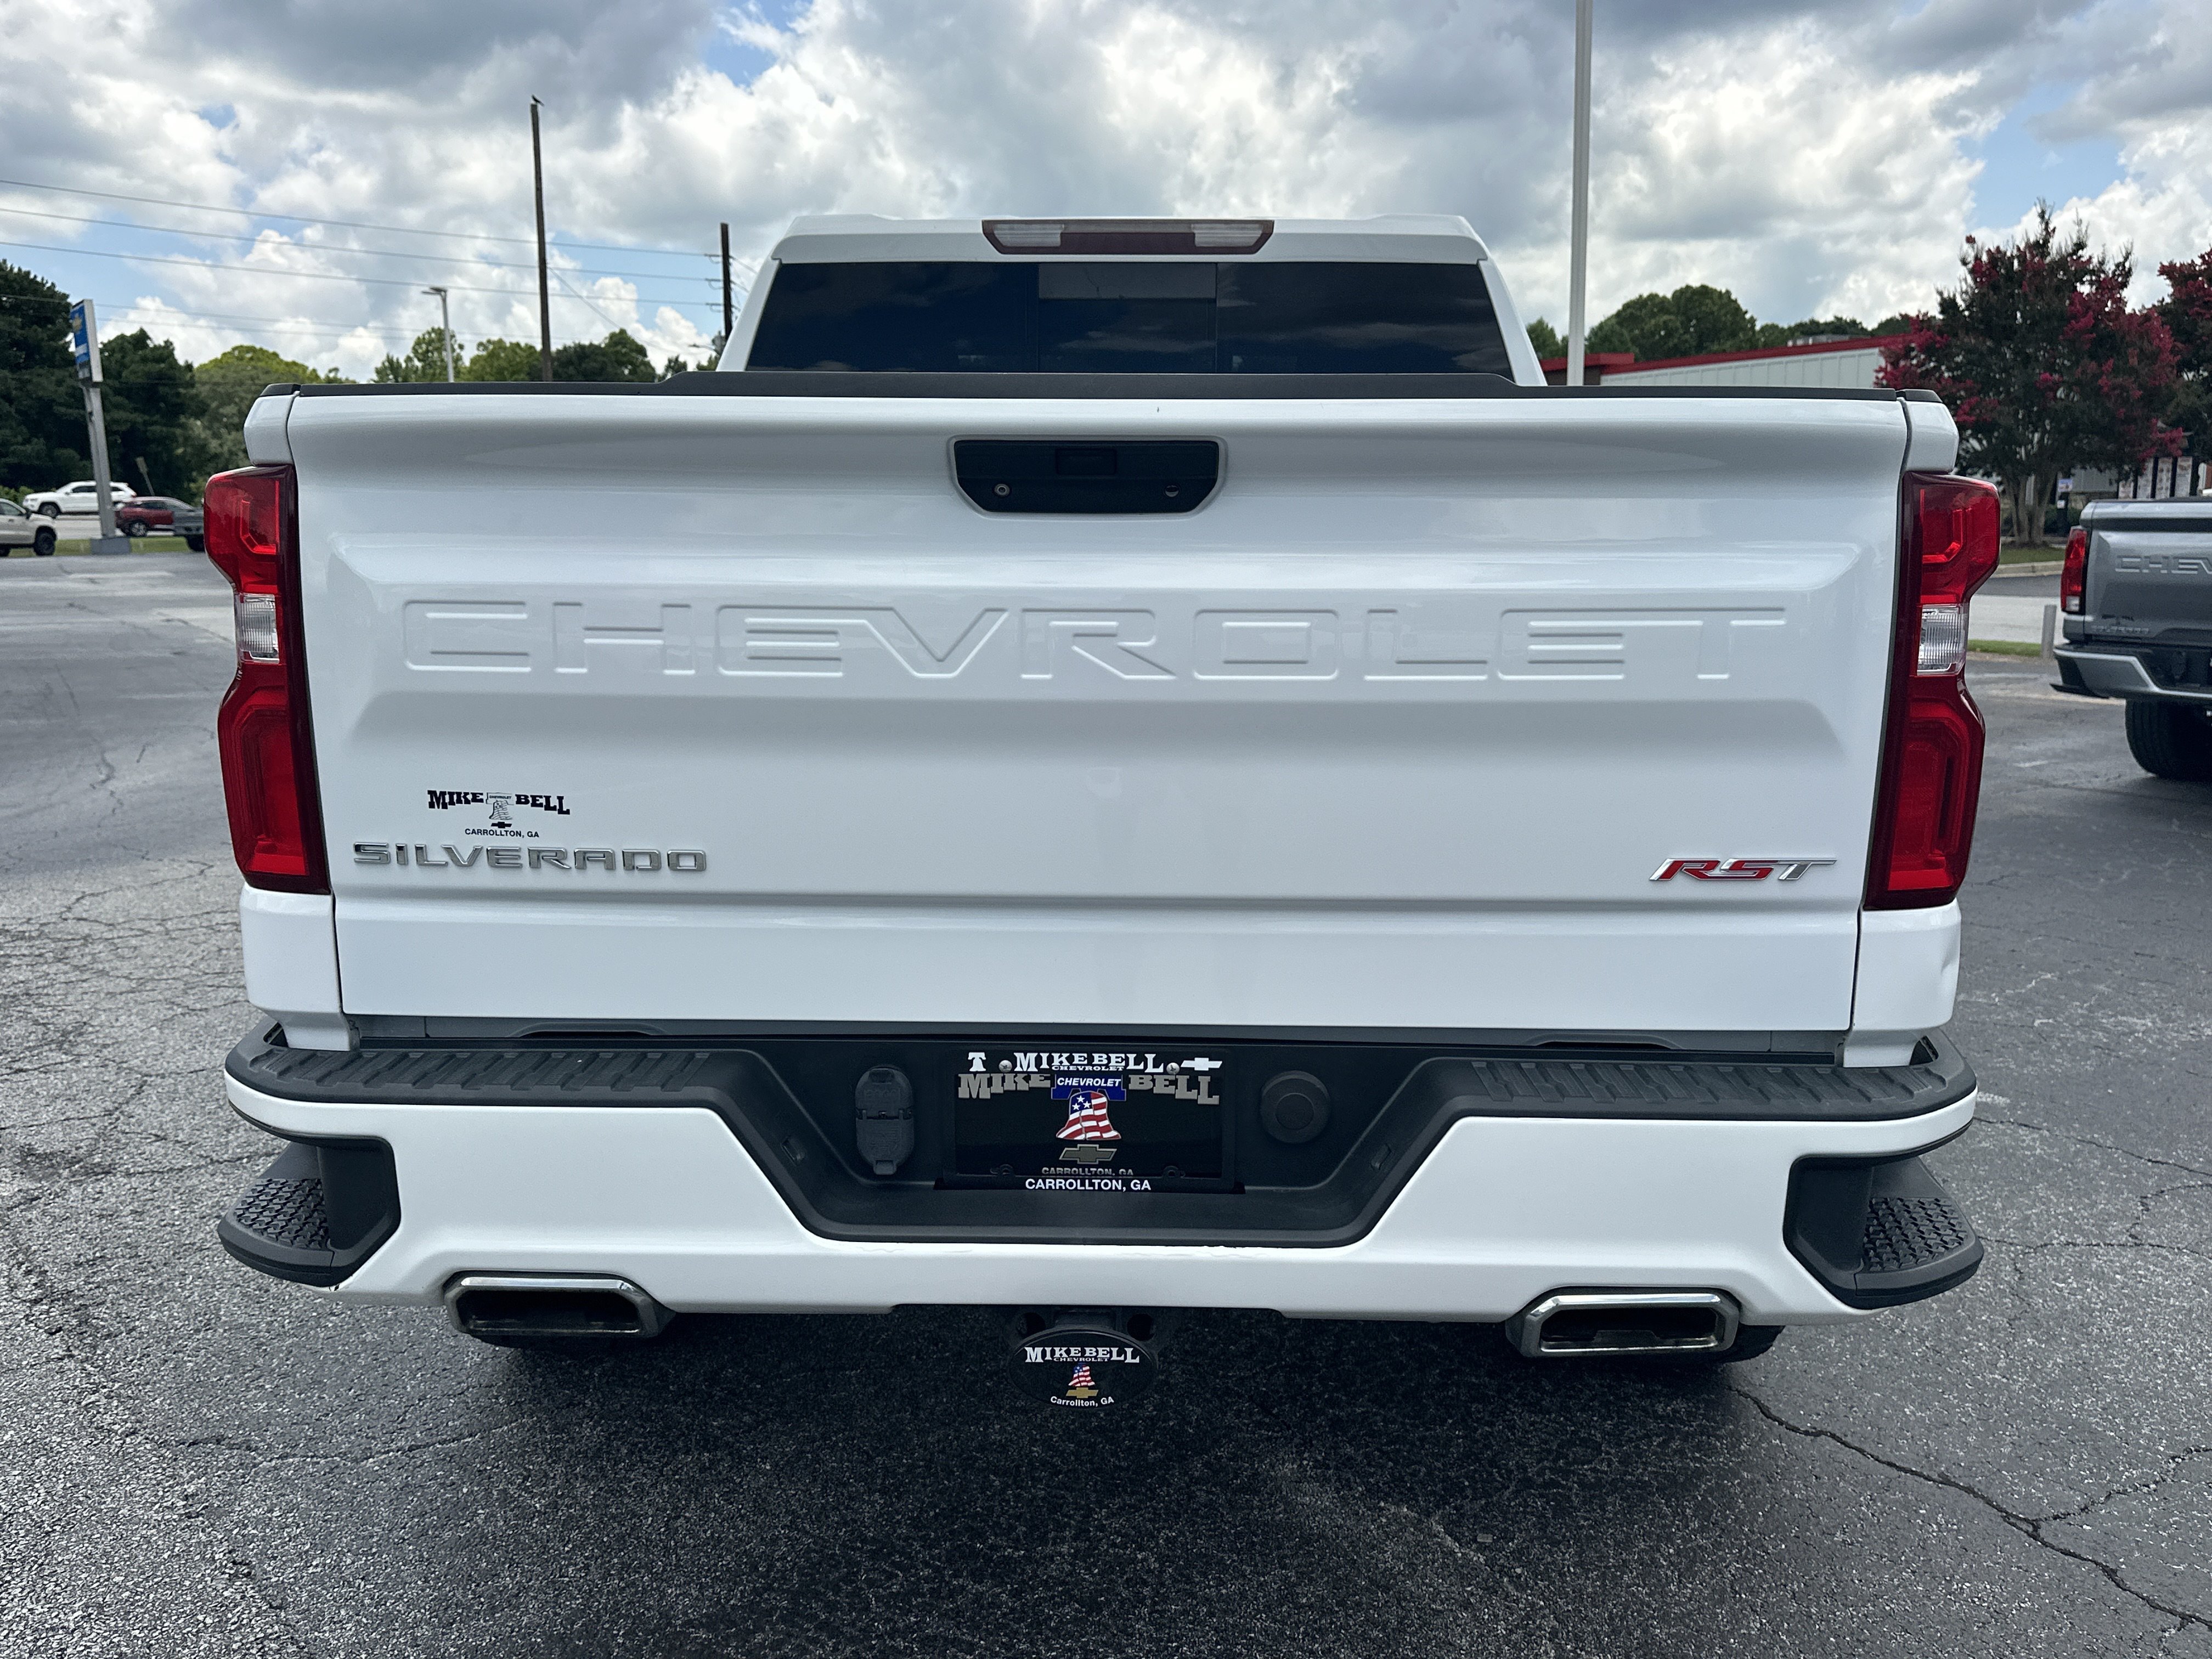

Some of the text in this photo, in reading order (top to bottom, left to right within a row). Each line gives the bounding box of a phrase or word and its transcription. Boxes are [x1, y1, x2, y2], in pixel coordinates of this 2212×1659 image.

[403, 600, 1786, 680] CHEVROLET
[427, 790, 571, 815] MIKE BELL
[465, 828, 524, 838] CARROLLTON,
[353, 842, 707, 871] SILVERADO
[1649, 858, 1837, 881] RST
[1014, 1052, 1164, 1073] MIKE BELL
[958, 1073, 1220, 1105] MIKE BELL
[1057, 1077, 1121, 1087] CHEVROLET
[1025, 1178, 1152, 1192] CARROLLTON, GA
[1024, 1347, 1140, 1363] MIKE BELL
[1050, 1396, 1115, 1407] Carrollton, GA
